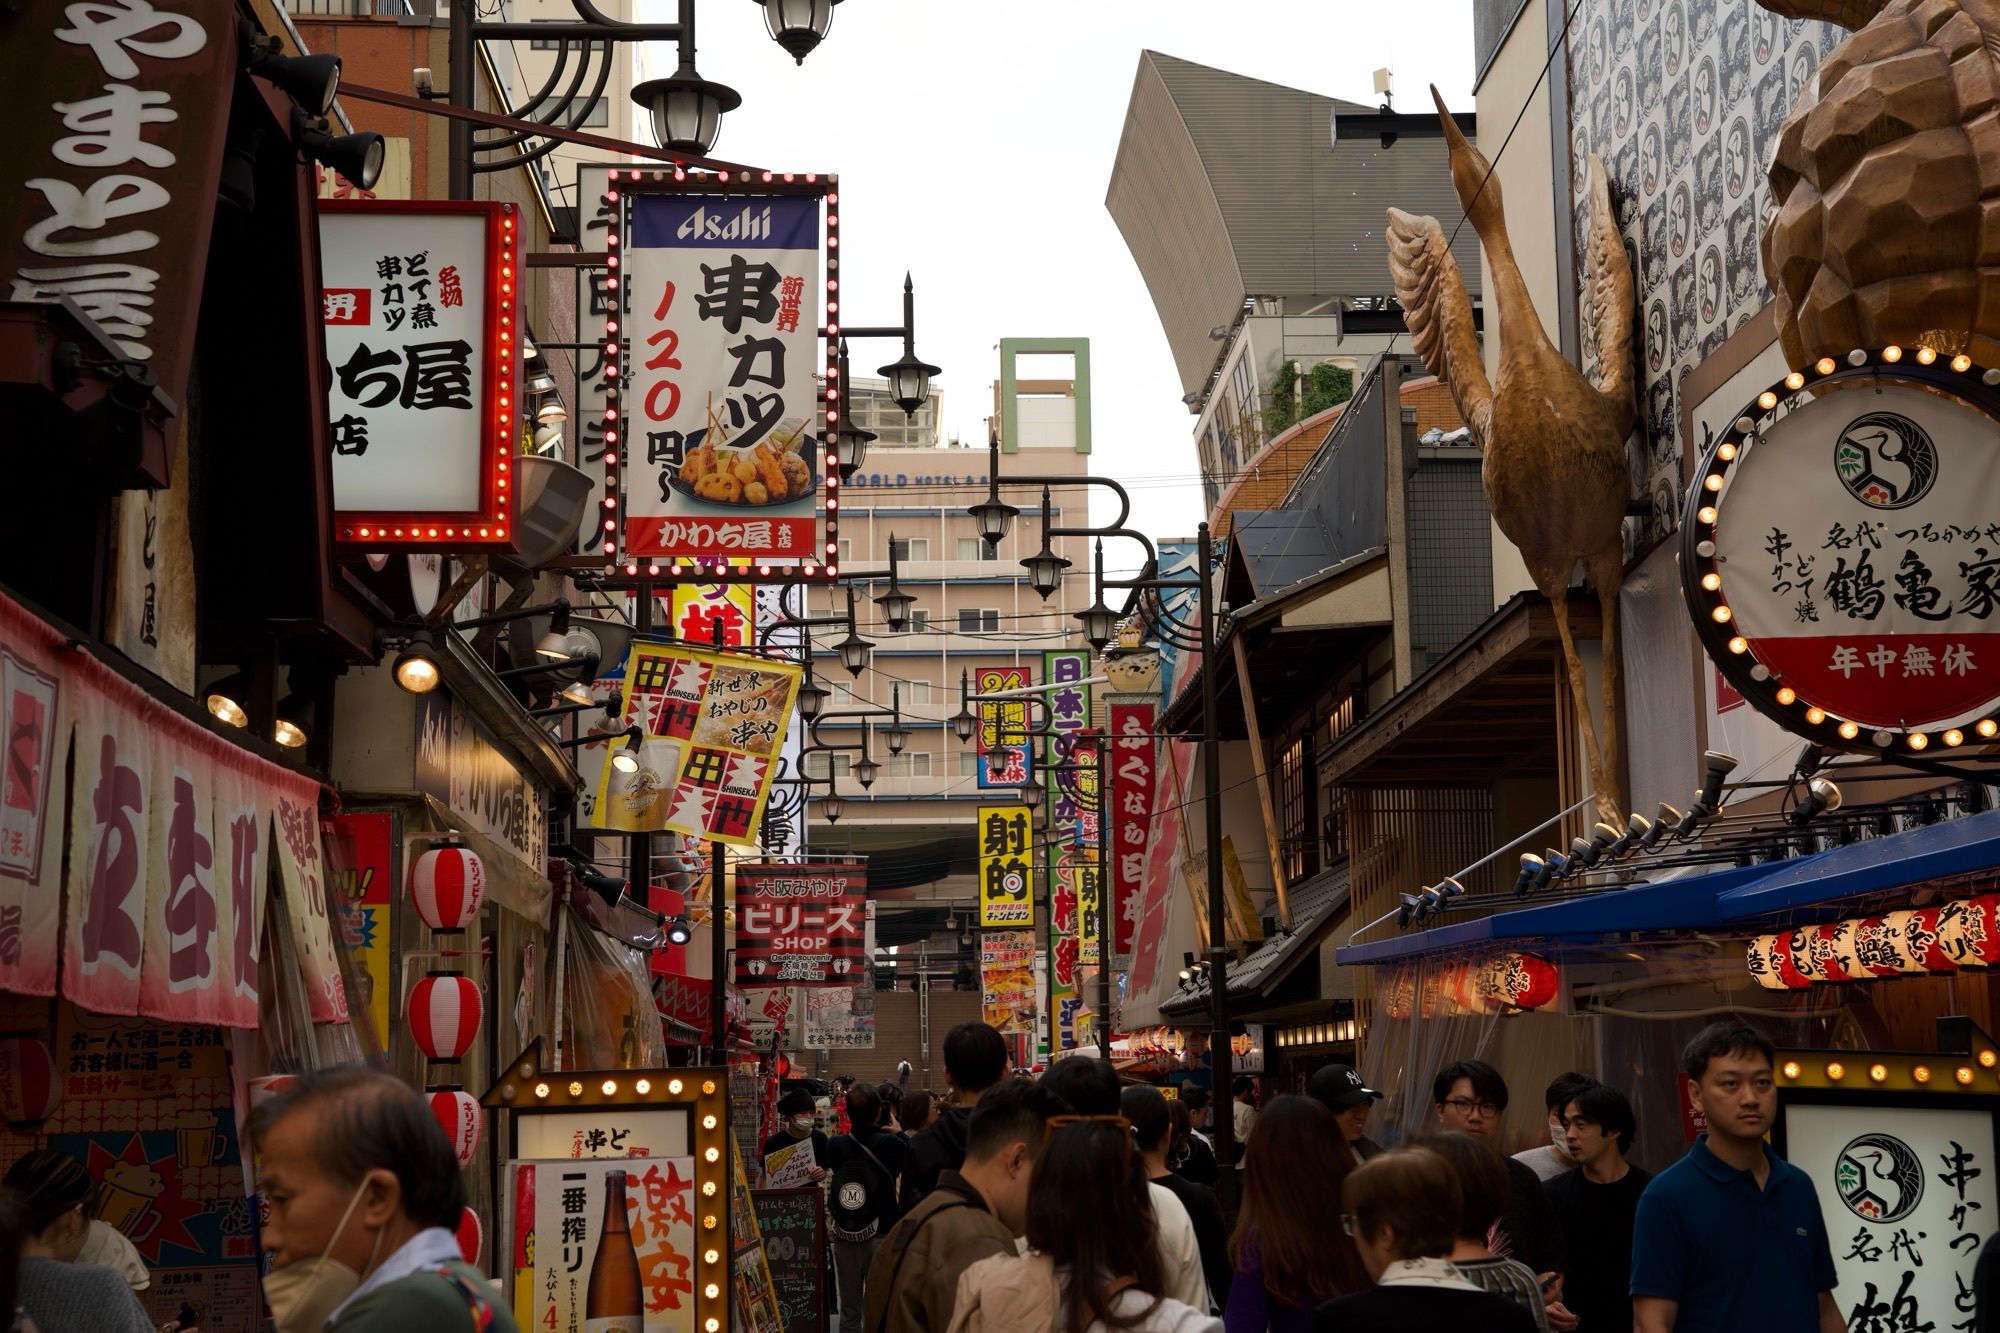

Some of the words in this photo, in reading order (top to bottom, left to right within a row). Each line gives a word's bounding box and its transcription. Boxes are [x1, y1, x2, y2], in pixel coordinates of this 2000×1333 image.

[677, 206, 771, 240] Asahi
[376, 255, 404, 331] 串カツ
[404, 251, 438, 329] どて煮
[439, 264, 463, 308] 名物
[776, 275, 804, 333] 新世界
[694, 253, 783, 449] 串カツ
[326, 340, 473, 410] ち屋
[915, 477, 957, 486] HOTEL
[658, 520, 772, 549] かわち屋
[777, 523, 792, 548] 本店
[1821, 521, 1886, 550] 名代
[1764, 527, 1793, 597] 串かつ
[1790, 553, 1820, 623] どて焼
[1828, 643, 1978, 679] 年中無休
[709, 672, 762, 697] 新世界
[709, 696, 768, 719] おやじの
[731, 718, 780, 750] 串や
[984, 813, 1028, 900] 射的
[756, 879, 846, 897] 大阪みやげ
[745, 904, 856, 934] ビリーズ
[773, 937, 828, 950] SHOP
[848, 1192, 857, 1201] M
[1938, 1140, 1982, 1257] 串かつ
[562, 1173, 587, 1273] 一番搾り
[1843, 1226, 1927, 1267] 名代
[542, 1304, 560, 1329] 4
